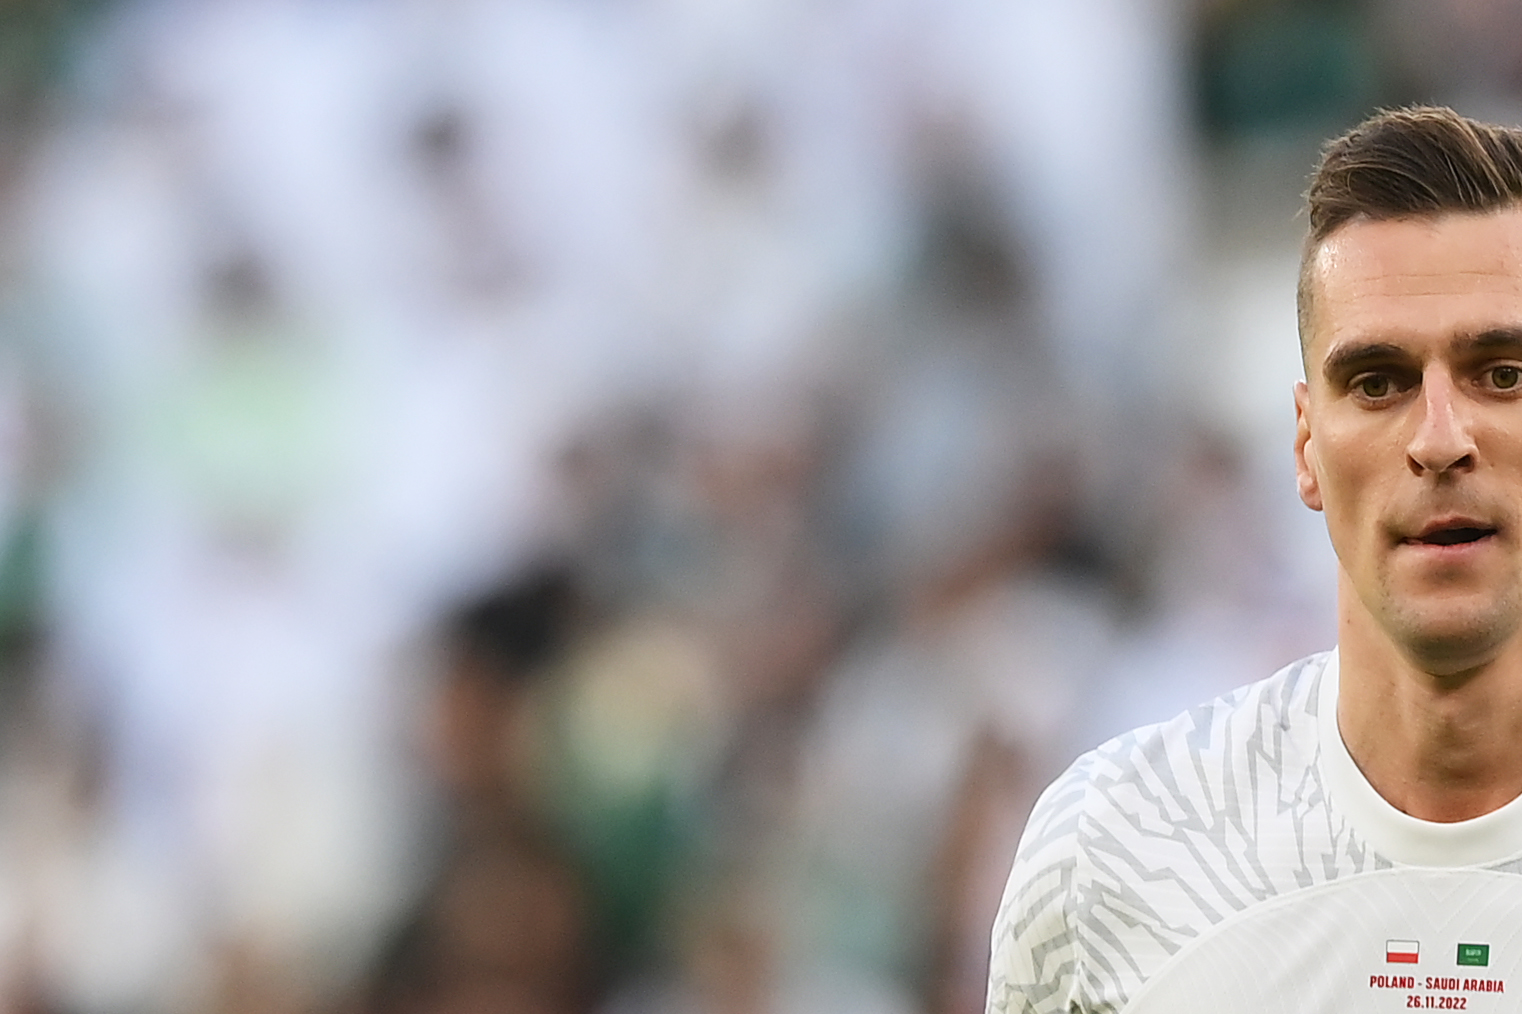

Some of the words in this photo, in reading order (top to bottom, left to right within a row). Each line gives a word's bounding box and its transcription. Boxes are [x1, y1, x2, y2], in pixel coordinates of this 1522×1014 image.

[1369, 975, 1415, 989] POLAND
[1425, 977, 1460, 991] SAUDI
[1462, 978, 1504, 993] ARABIA
[1406, 995, 1467, 1010] 26.11.2022
